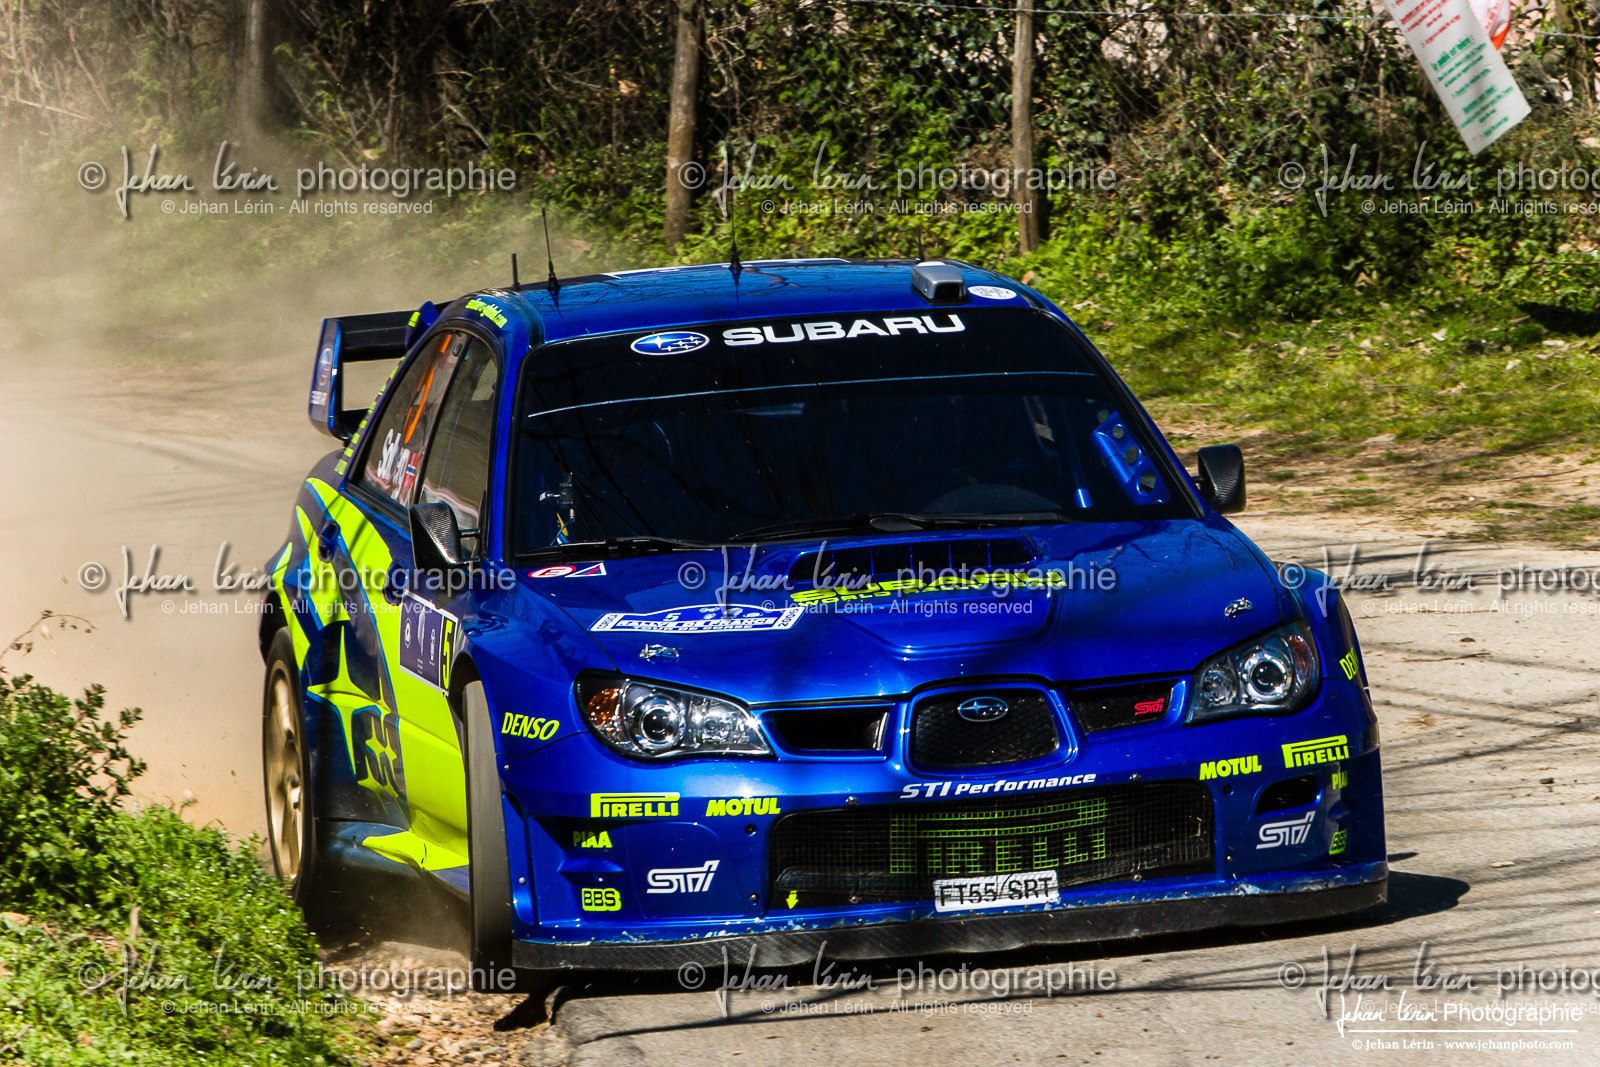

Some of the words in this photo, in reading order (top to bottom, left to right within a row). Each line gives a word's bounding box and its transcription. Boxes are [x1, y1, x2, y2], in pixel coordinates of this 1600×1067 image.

[723, 314, 966, 347] SUBARU
[790, 570, 1062, 602] SUBARU
[798, 591, 891, 607] WORLD
[663, 612, 681, 622] 5
[443, 619, 453, 690] 5
[501, 712, 560, 741] DENSO
[1281, 734, 1350, 768] PIRELLI
[1199, 755, 1262, 781] MOTUL
[900, 779, 952, 799] STI
[955, 773, 1096, 795] Performance
[590, 792, 680, 818] PIRELLI
[706, 798, 781, 817] MOTUL
[573, 830, 612, 848] PIAA
[890, 799, 1107, 874] PIRELLI
[583, 889, 618, 907] BBS
[940, 882, 997, 907] FT55
[1008, 876, 1053, 900] SRT
